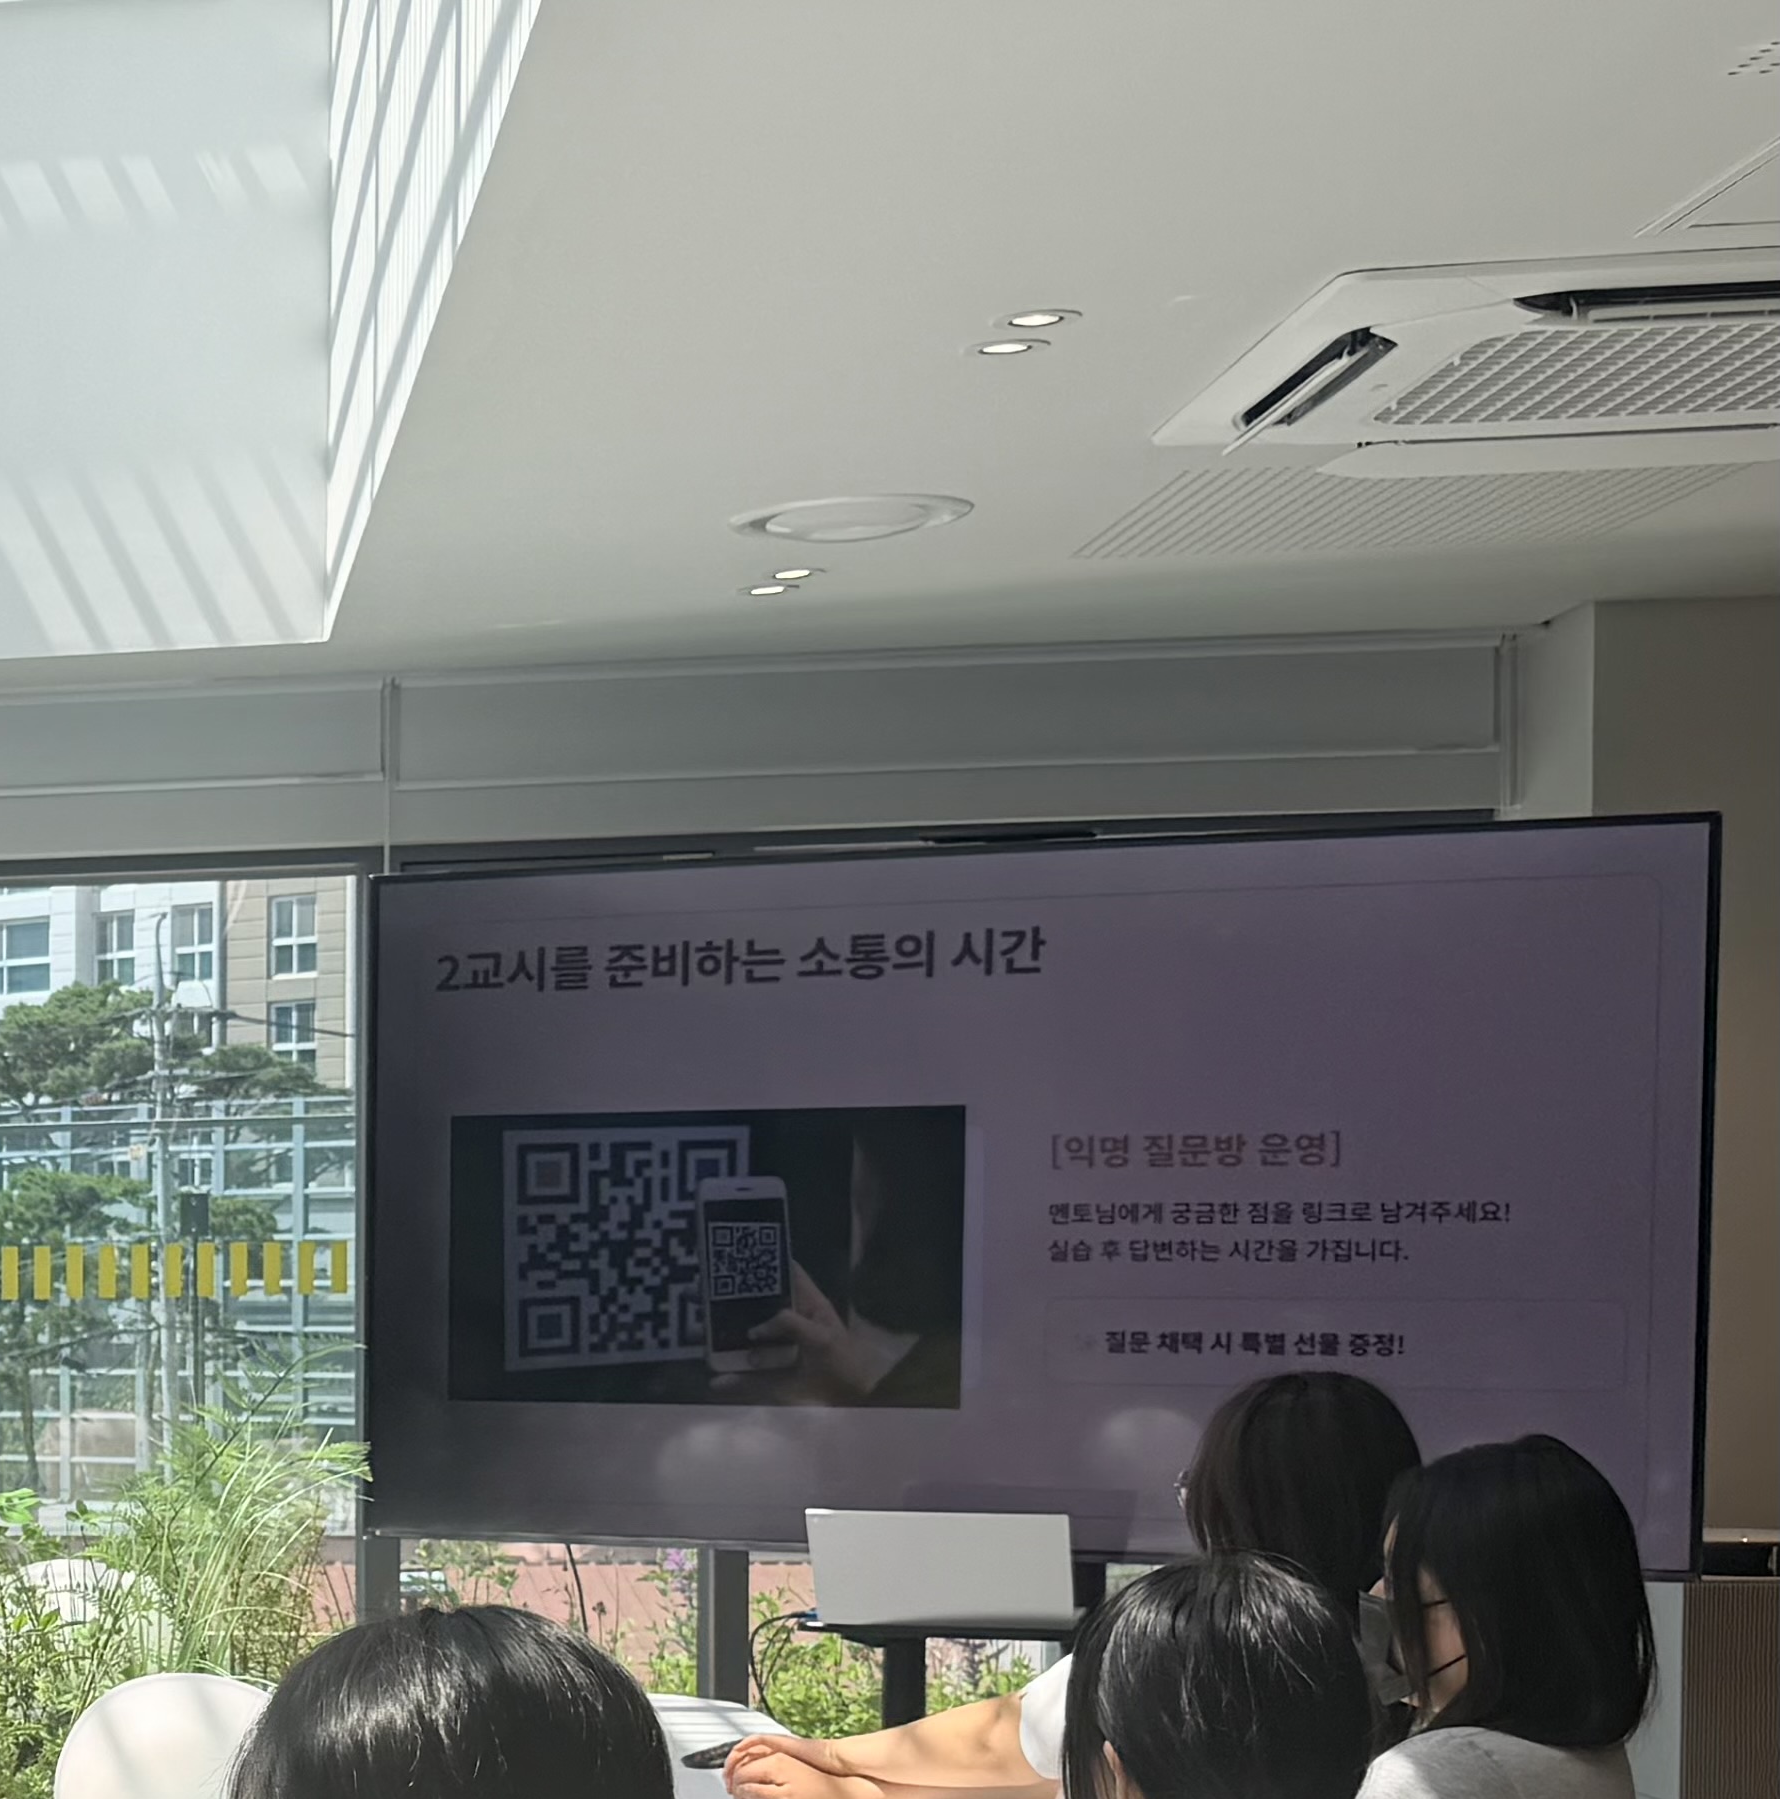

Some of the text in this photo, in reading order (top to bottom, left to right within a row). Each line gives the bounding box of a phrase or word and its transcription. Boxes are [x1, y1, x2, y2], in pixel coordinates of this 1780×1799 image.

[436, 924, 1048, 994] 2교시를 준비하는 소통의 시간
[1050, 1130, 1342, 1170] [익명 질문방 운영]
[1048, 1200, 1511, 1226] 멘토님에게 궁금한 점을 링크로 남겨주세요!
[1047, 1238, 1409, 1264] 실습 후 답변하는 시간을 가집니다.
[1104, 1330, 1405, 1357] 질문 채택 시 특별 선물 증정!
